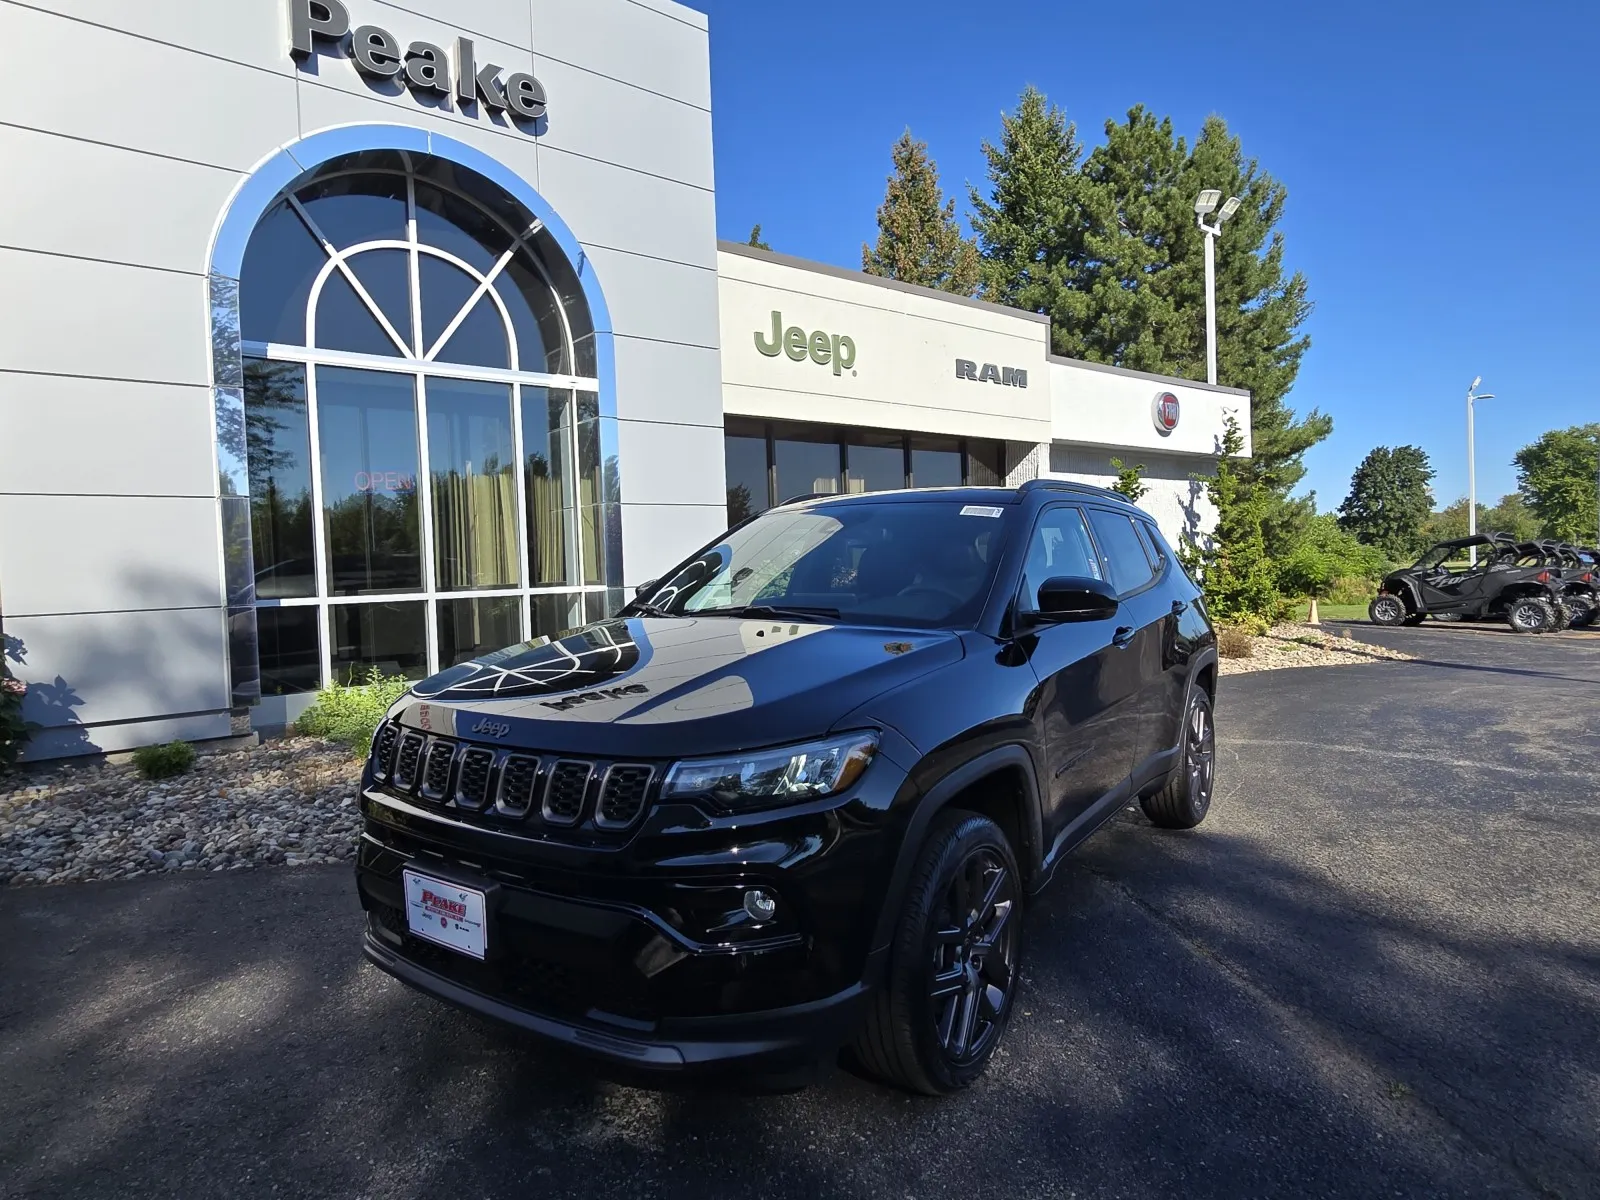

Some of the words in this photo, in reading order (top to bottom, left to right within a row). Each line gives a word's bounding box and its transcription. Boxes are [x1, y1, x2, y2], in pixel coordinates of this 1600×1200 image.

[289, 0, 548, 119] Peake
[754, 310, 856, 377] Jeep
[955, 358, 1028, 388] RAM
[354, 471, 411, 491] OPEN
[471, 717, 510, 739] Jeep
